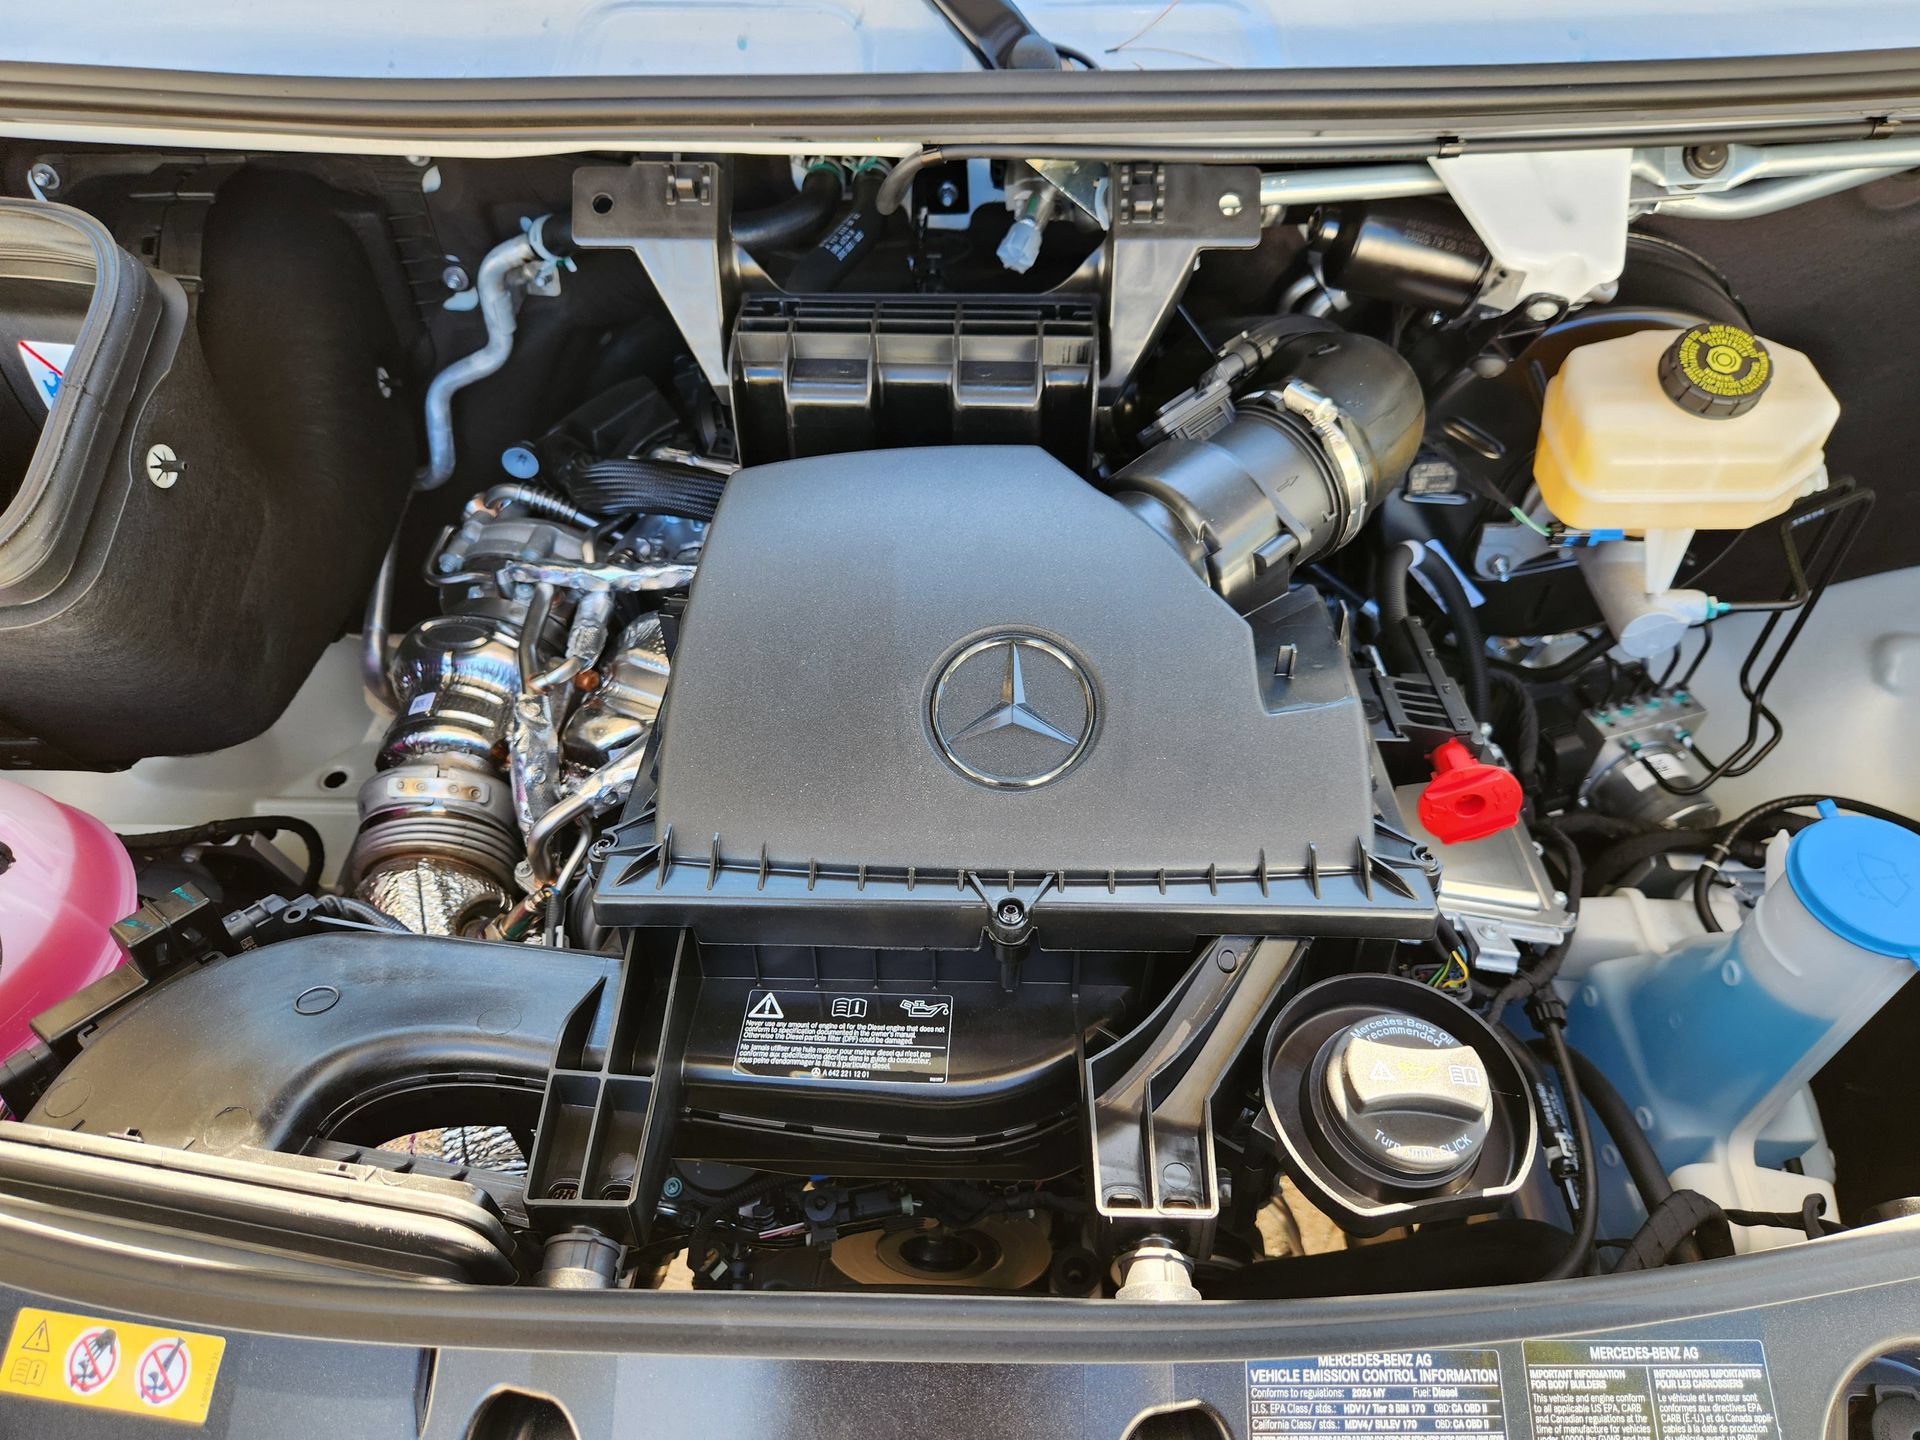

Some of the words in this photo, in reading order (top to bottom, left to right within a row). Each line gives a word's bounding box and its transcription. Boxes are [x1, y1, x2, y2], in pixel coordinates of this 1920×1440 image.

[745, 1025, 770, 1033] conform
[818, 1022, 838, 1030] engine
[867, 1023, 885, 1031] Diesel
[886, 1024, 905, 1032] engine
[1350, 1017, 1436, 1038] Mercedes-Benz
[1439, 1032, 1454, 1045] Oil
[1366, 1027, 1442, 1048] recommended
[839, 1048, 854, 1056] pour
[1374, 1129, 1401, 1151] Turn
[1590, 1346, 1681, 1360] MERCEDES-BENZ
[1684, 1347, 1698, 1360] AG
[1318, 1354, 1413, 1366] MERCEDES-BENZ
[1415, 1354, 1432, 1366] AG
[1250, 1369, 1300, 1382] VEHICLE
[1303, 1369, 1359, 1382] EMISSION
[1362, 1369, 1417, 1382] CONTROL
[1420, 1369, 1497, 1382] INFORMATION
[1530, 1370, 1572, 1379] IMPORTANT
[1574, 1370, 1626, 1379] INFORMATION
[1654, 1369, 1709, 1378] INFORMATIONS
[1710, 1369, 1761, 1378] IMPORTANTES
[1531, 1380, 1547, 1389] FOR
[1548, 1380, 1568, 1389] BODY
[1570, 1380, 1607, 1389] BUILDERS
[1656, 1380, 1676, 1389] POUR
[1678, 1380, 1691, 1389] LES
[1693, 1380, 1744, 1389] CARROSSIERS
[1251, 1388, 1289, 1398] Conforms
[1291, 1388, 1298, 1398] to
[1300, 1388, 1344, 1399] regulations:
[1352, 1388, 1371, 1398] 2026
[1374, 1388, 1386, 1398] MY
[1413, 1387, 1431, 1397] Fuel:
[1432, 1387, 1458, 1397] Diesel
[1532, 1393, 1548, 1402] This
[1549, 1393, 1574, 1402] vehicle
[1576, 1393, 1589, 1402] and
[1590, 1394, 1614, 1404] engine
[1616, 1393, 1645, 1402] conform
[1658, 1393, 1666, 1402] Le
[1698, 1393, 1706, 1402] et
[1707, 1393, 1714, 1402] le
[1715, 1393, 1740, 1402] moteur
[1742, 1393, 1758, 1402] sont
[1252, 1404, 1268, 1414] U.S.
[1270, 1404, 1286, 1414] EPA
[1287, 1404, 1313, 1415] Class/
[1412, 1404, 1425, 1413] 170
[1434, 1404, 1451, 1413] OBD:
[1452, 1404, 1463, 1413] CA
[1464, 1404, 1480, 1413] OBD
[1544, 1404, 1552, 1412] all
[1554, 1404, 1590, 1414] applicable
[1591, 1404, 1602, 1412] US
[1621, 1404, 1642, 1412] CARB
[1659, 1404, 1696, 1412] conformes
[1712, 1404, 1746, 1412] directives
[1536, 1414, 1549, 1423] and
[1550, 1414, 1584, 1423] Canadian
[1585, 1414, 1625, 1424] regulations
[1626, 1415, 1634, 1423] at
[1635, 1414, 1647, 1423] the
[1661, 1414, 1681, 1423] CARB
[1706, 1414, 1713, 1423] et
[1715, 1414, 1724, 1423] du
[1725, 1414, 1752, 1423] Canada
[1252, 1420, 1289, 1430] California
[1291, 1419, 1316, 1430] Class/
[1375, 1420, 1400, 1430] SULEV
[1403, 1420, 1417, 1429] 170
[1435, 1419, 1452, 1429] OBD:
[1453, 1419, 1464, 1429] CA
[1466, 1419, 1482, 1429] OBD
[1663, 1425, 1686, 1433] cables
[1702, 1425, 1717, 1433] date
[1719, 1425, 1728, 1433] de
[1730, 1424, 1768, 1434] production
[1536, 1425, 1552, 1434] time
[1554, 1425, 1561, 1434] of
[1563, 1425, 1608, 1434] manufacture
[1610, 1425, 1620, 1434] for
[1622, 1425, 1650, 1434] vehicles
